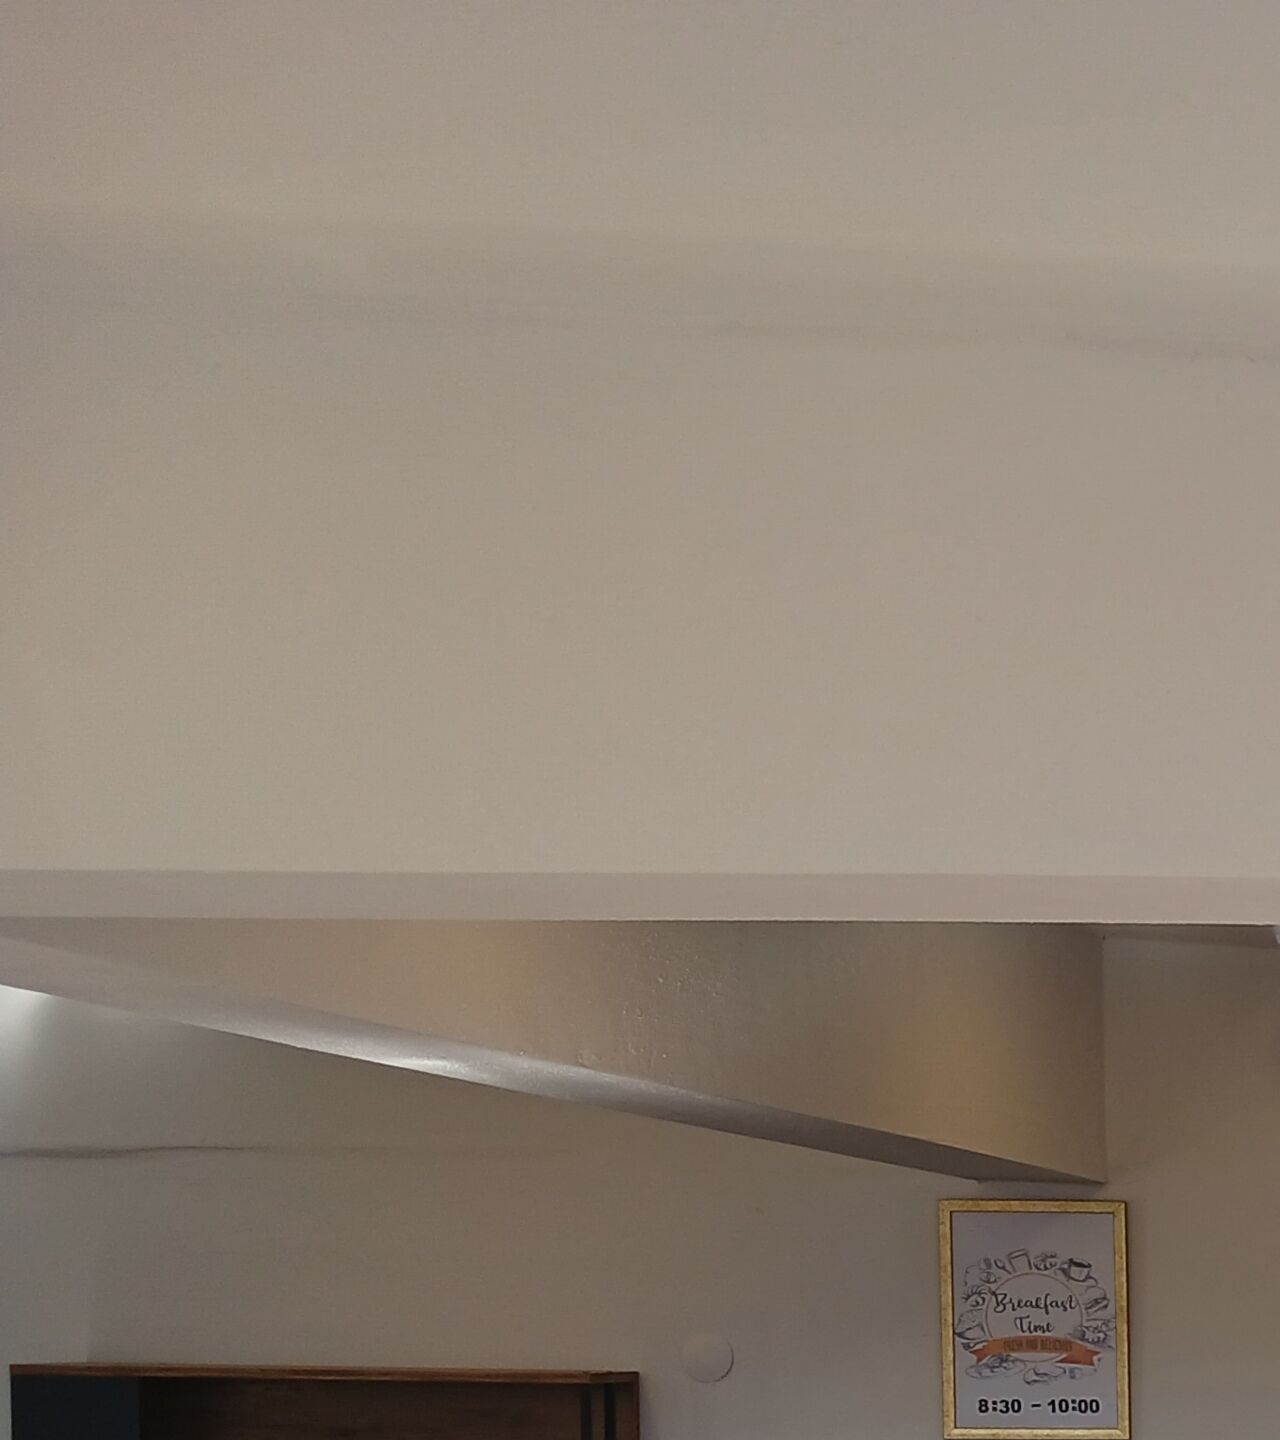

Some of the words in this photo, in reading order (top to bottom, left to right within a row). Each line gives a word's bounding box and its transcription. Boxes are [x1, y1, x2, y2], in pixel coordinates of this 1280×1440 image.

[992, 1292, 1077, 1315] Breakfast
[1014, 1315, 1054, 1334] Time
[977, 1399, 1022, 1414] 8:30
[1047, 1398, 1101, 1414] 10:00
